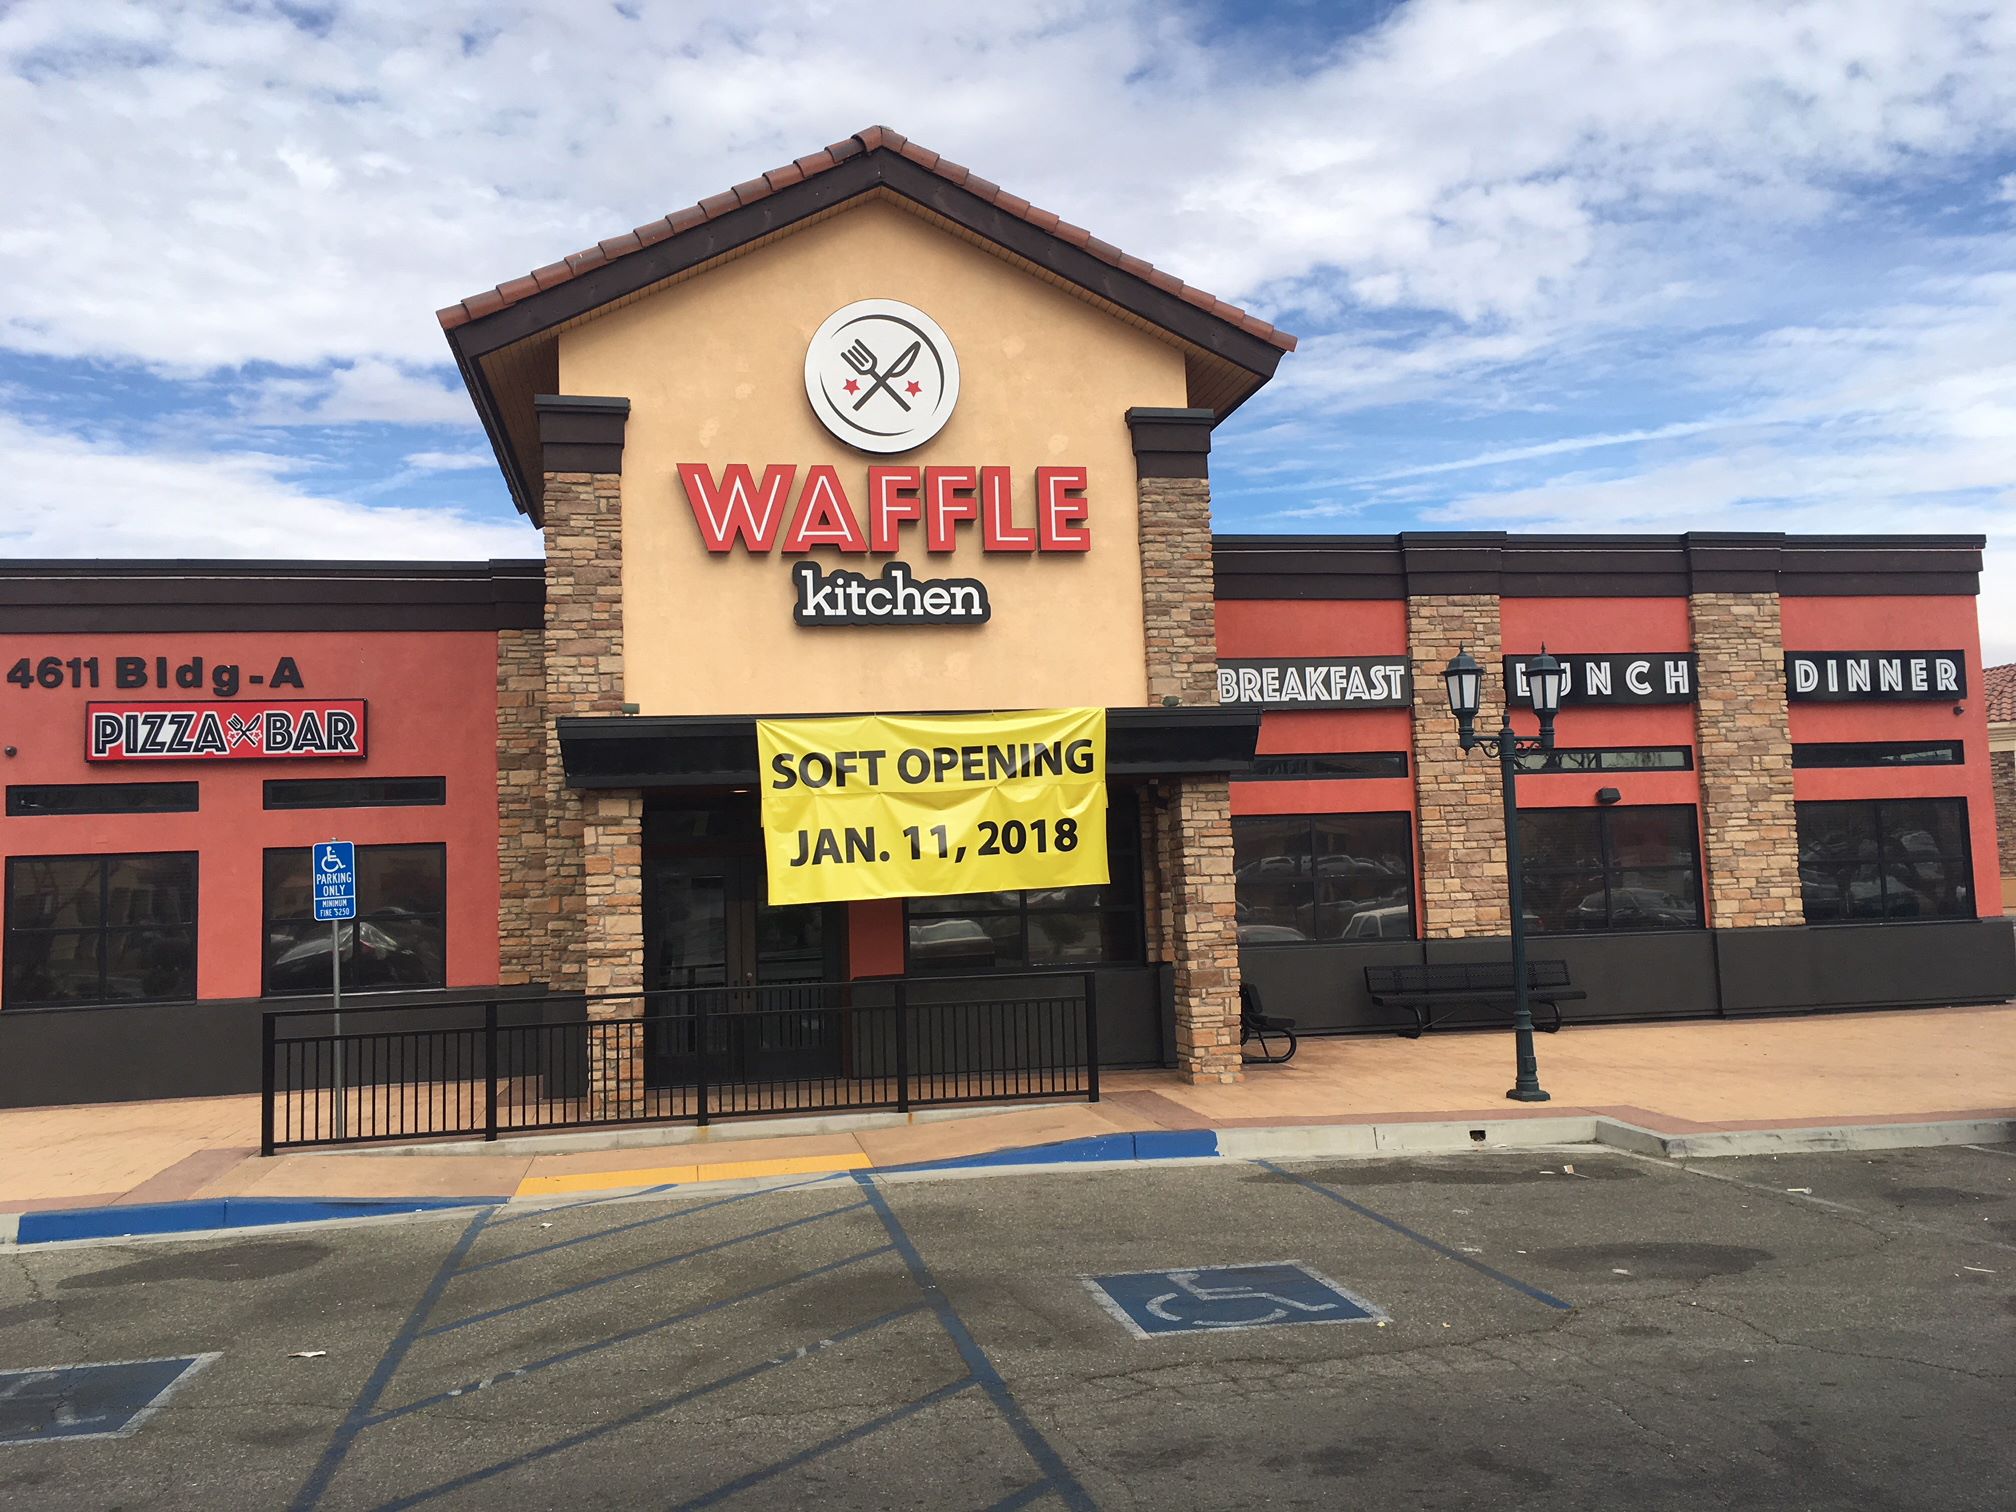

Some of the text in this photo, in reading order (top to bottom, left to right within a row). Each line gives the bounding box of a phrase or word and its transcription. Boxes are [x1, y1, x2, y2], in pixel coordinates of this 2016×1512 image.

[676, 463, 1091, 554] WAFFLE
[800, 569, 983, 616] kitchen
[6, 656, 304, 697] 4611 Bldg-A
[1217, 665, 1405, 703] BREAKFAST
[1795, 658, 1959, 693] DINNER
[93, 709, 360, 756] PIZZA BAR
[771, 739, 1094, 789] SOFT OPENING
[790, 818, 1078, 867] JAN. 11, 2018
[316, 872, 352, 885] PARKING
[323, 884, 346, 896] ONLY
[320, 908, 333, 917] FINE
[322, 898, 348, 908] MINIMUM
